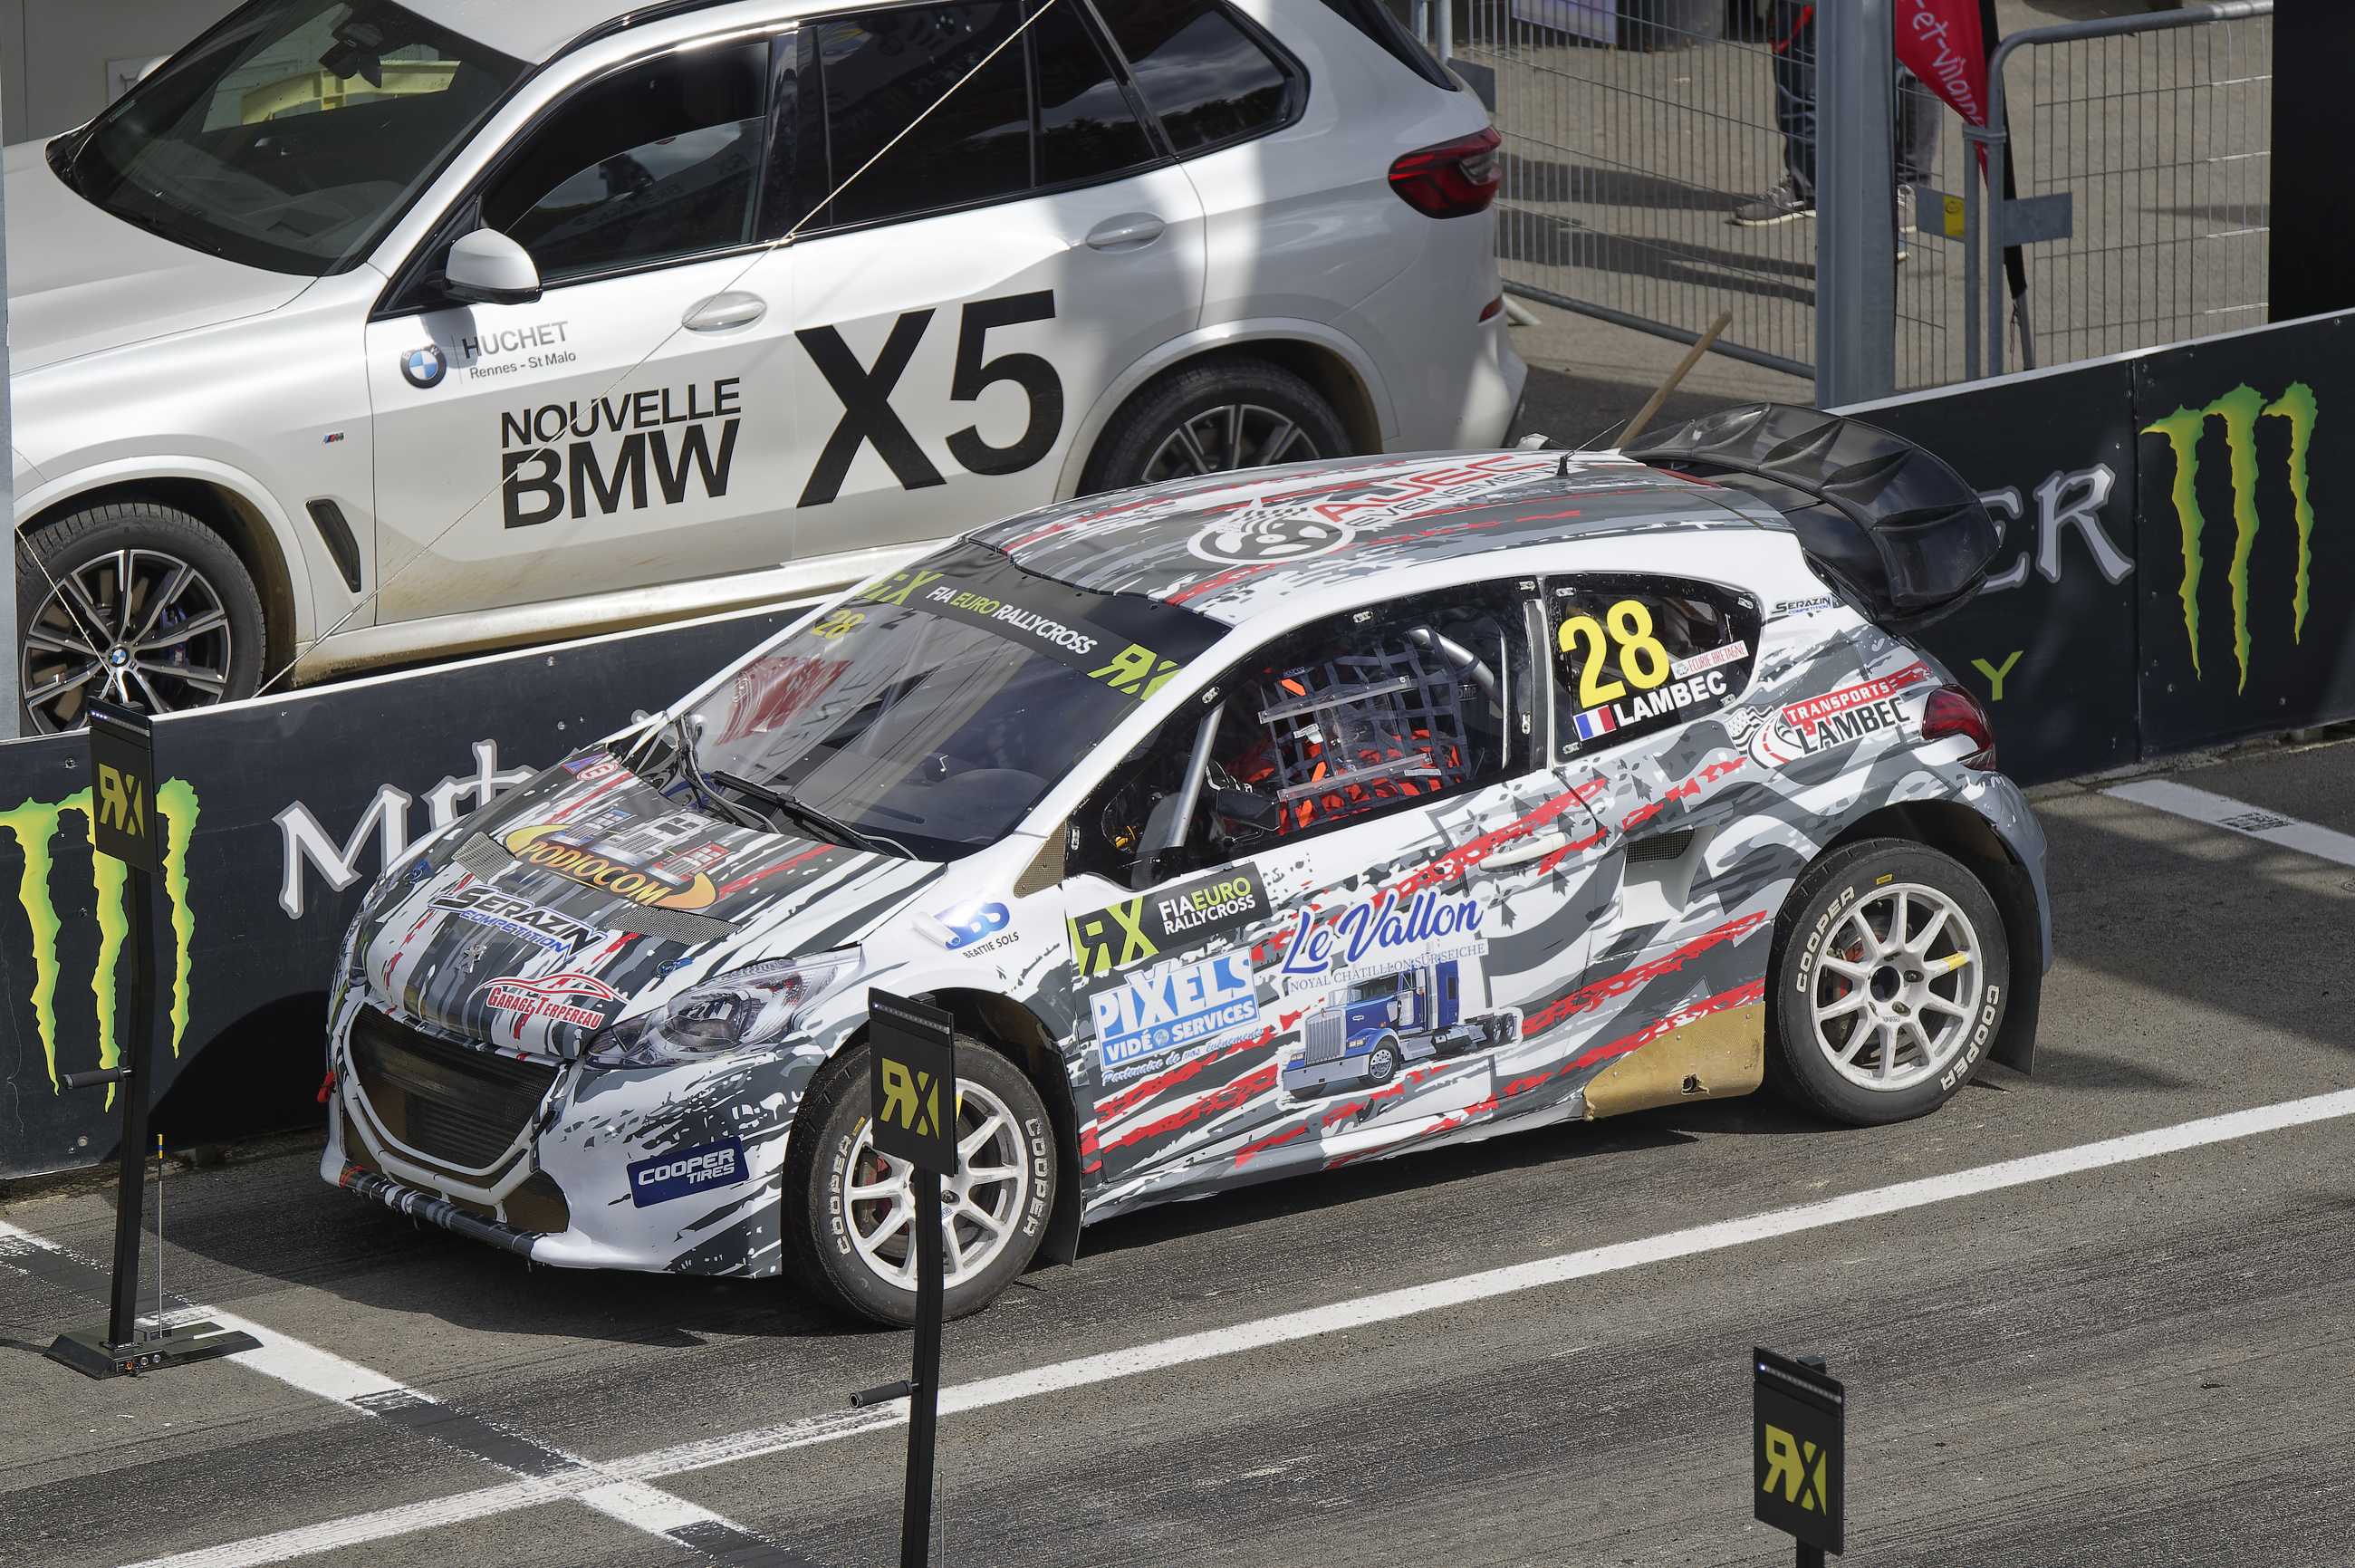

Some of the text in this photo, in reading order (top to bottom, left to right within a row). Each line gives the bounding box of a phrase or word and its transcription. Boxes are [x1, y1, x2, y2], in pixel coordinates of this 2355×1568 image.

[461, 321, 569, 360] HUCHET
[469, 361, 518, 380] Rennes
[528, 355, 543, 369] St
[545, 350, 577, 366] Malo
[501, 377, 742, 448] NOUVELLE
[793, 289, 1064, 509] X5
[501, 418, 741, 529] BMW
[1315, 455, 1555, 524] AJEC
[812, 608, 866, 640] 28
[925, 585, 1097, 655] FIA EURO RALLYCROSS
[1558, 600, 1670, 709] 28
[1615, 670, 1727, 726] LAMBEC
[1787, 681, 1890, 724] TRANSPORTS
[1794, 697, 1910, 755] LAMBEC
[99, 763, 145, 840] RX
[517, 841, 673, 906] PODIOCOM
[431, 887, 601, 955] SERAZIN
[460, 909, 571, 954] COMPETITION
[995, 931, 1020, 948] SOLS
[1162, 894, 1256, 936] RALLYCROSS
[1282, 891, 1484, 975] Le Vallon
[1796, 885, 1855, 993] COOPER
[1097, 955, 1253, 1041] PIXELS
[1290, 975, 1331, 993] NOYAL
[1439, 942, 1485, 962] SEICHE
[487, 986, 602, 1029] GARAGE TERPEREAU
[1171, 1000, 1254, 1043] SERVICES
[1940, 985, 2000, 1091] COOPER
[880, 1057, 939, 1140] RX
[638, 1148, 735, 1186] COOPER
[687, 1162, 735, 1184] TIRES
[829, 1135, 851, 1255] COOPER
[1023, 1117, 1048, 1236] COOPER
[1763, 1423, 1826, 1515] RX
